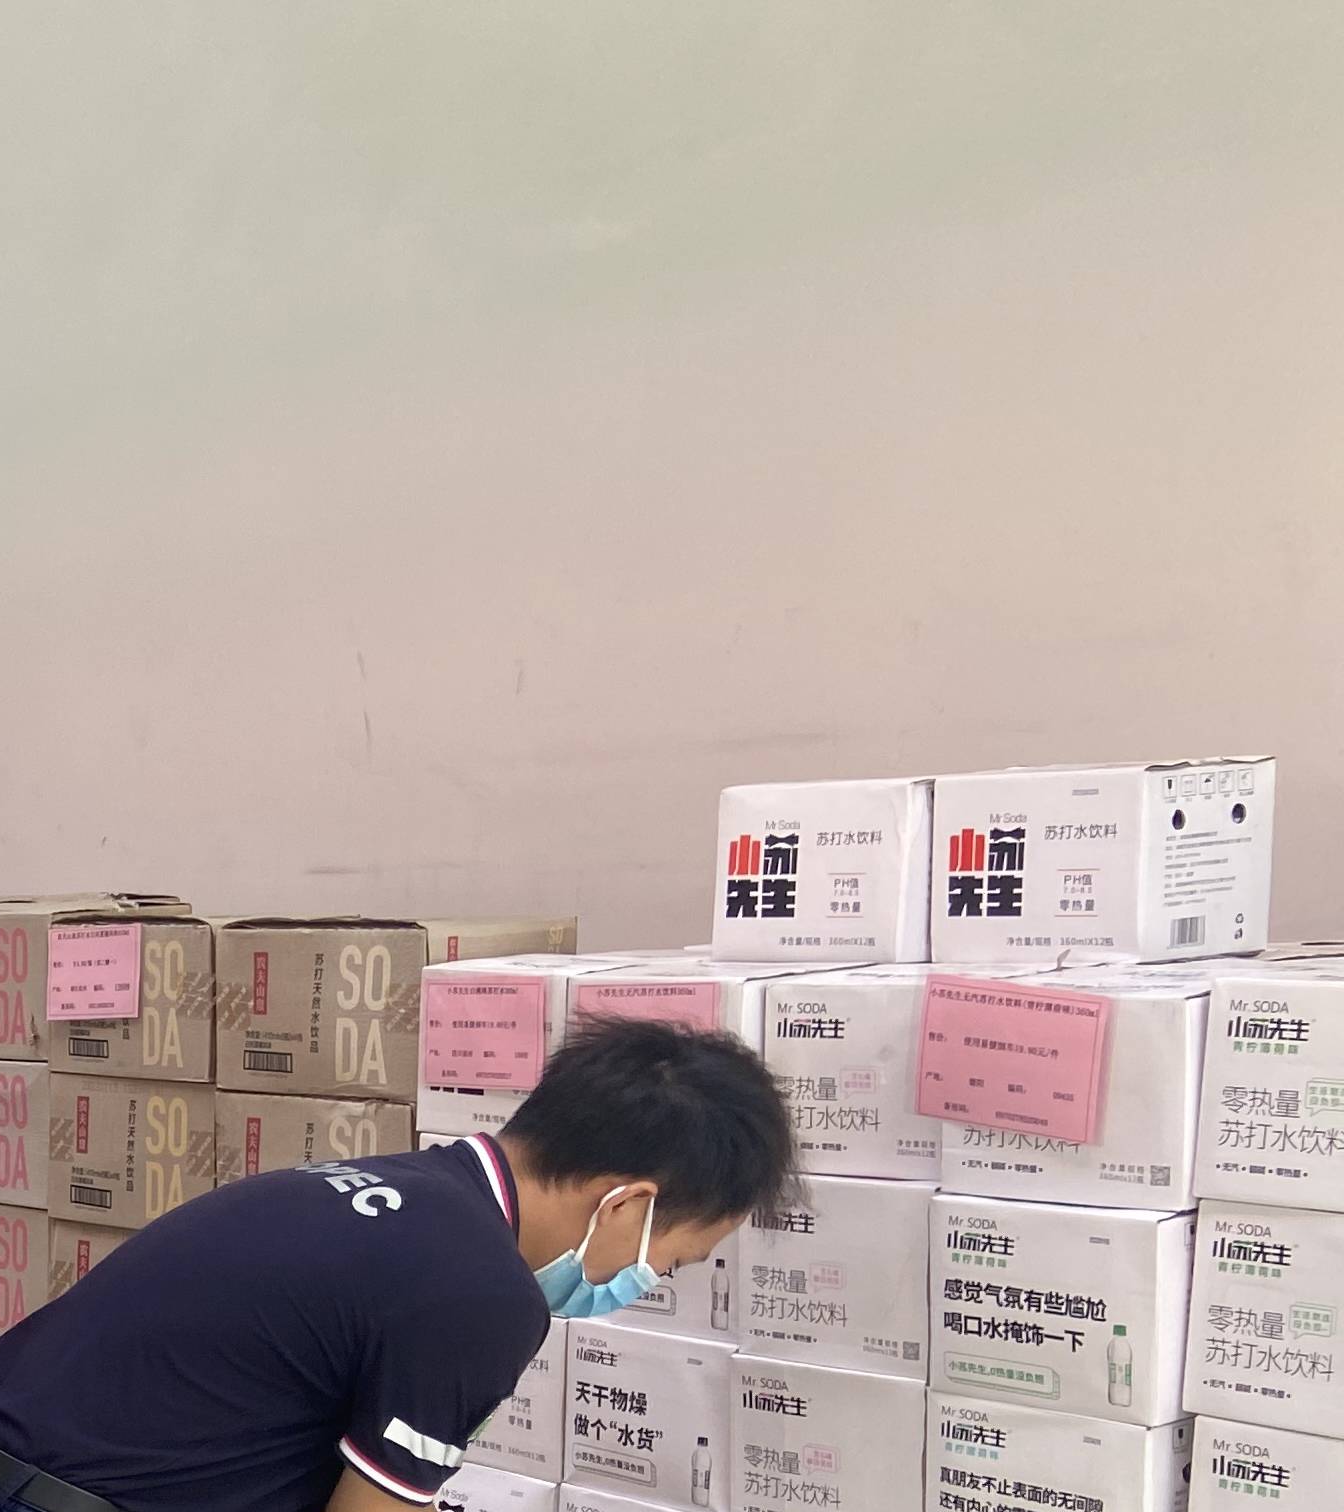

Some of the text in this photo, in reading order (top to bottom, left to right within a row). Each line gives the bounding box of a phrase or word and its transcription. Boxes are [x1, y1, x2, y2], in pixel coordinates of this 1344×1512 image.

[816, 831, 882, 846] 苏打水饮料
[1044, 823, 1118, 840] 苏打水饮料
[834, 879, 859, 889] PH值
[1064, 875, 1092, 885] PH值
[726, 878, 796, 918] 先生
[830, 902, 861, 913] 零热量
[948, 875, 1023, 917] 先生
[1060, 899, 1095, 911] 零热量
[779, 937, 821, 945] 净含量/规格
[1006, 937, 1051, 946] 净含量/规格
[143, 940, 185, 1000] SO
[337, 945, 391, 1011] SO
[310, 954, 324, 1053] 苏打天然水饮品
[797, 1003, 827, 1014] SODA
[1252, 1001, 1289, 1013] SODA
[143, 1007, 183, 1068] DA
[777, 1018, 845, 1039] 小苏先生
[1227, 1016, 1310, 1041] 小苏先生
[335, 1018, 387, 1085] DA
[775, 1076, 838, 1101] 零热量
[1221, 1086, 1302, 1118] 零热量
[145, 1096, 188, 1156] SO
[328, 1116, 377, 1159] SO
[1218, 1120, 1344, 1156] 苏打水饮料
[126, 1100, 136, 1192] 苏打天然水饮品
[146, 1161, 184, 1219] DA
[948, 1216, 997, 1230] Mr SODA
[1236, 1223, 1271, 1237] SODA
[947, 1231, 1015, 1256] 小苏先生
[1212, 1238, 1292, 1266] 小苏先生
[751, 1265, 808, 1294] 零热量
[751, 1292, 848, 1328] 苏打水饮料
[944, 1278, 1107, 1322] 感觉气氛有些尴尬
[944, 1312, 1085, 1352] 喝口水掩饰一下
[1208, 1304, 1285, 1340] 零热量
[576, 1347, 617, 1367] 小苏先生
[589, 1338, 607, 1348] SODA
[1205, 1338, 1334, 1382] 苏打水饮料
[742, 1376, 788, 1392] Mr SODA
[576, 1381, 647, 1416] 天干物燥
[743, 1391, 807, 1417] 小苏先生
[508, 1415, 532, 1430] 零热量
[941, 1406, 989, 1423] Mr SODA
[574, 1413, 663, 1452] 做个“水货”
[941, 1421, 1006, 1448] 小苏先生
[744, 1444, 801, 1475] 零热量
[1235, 1442, 1270, 1459] SODA
[1212, 1455, 1290, 1488] 小苏先生
[744, 1472, 841, 1510] 苏打水饮料
